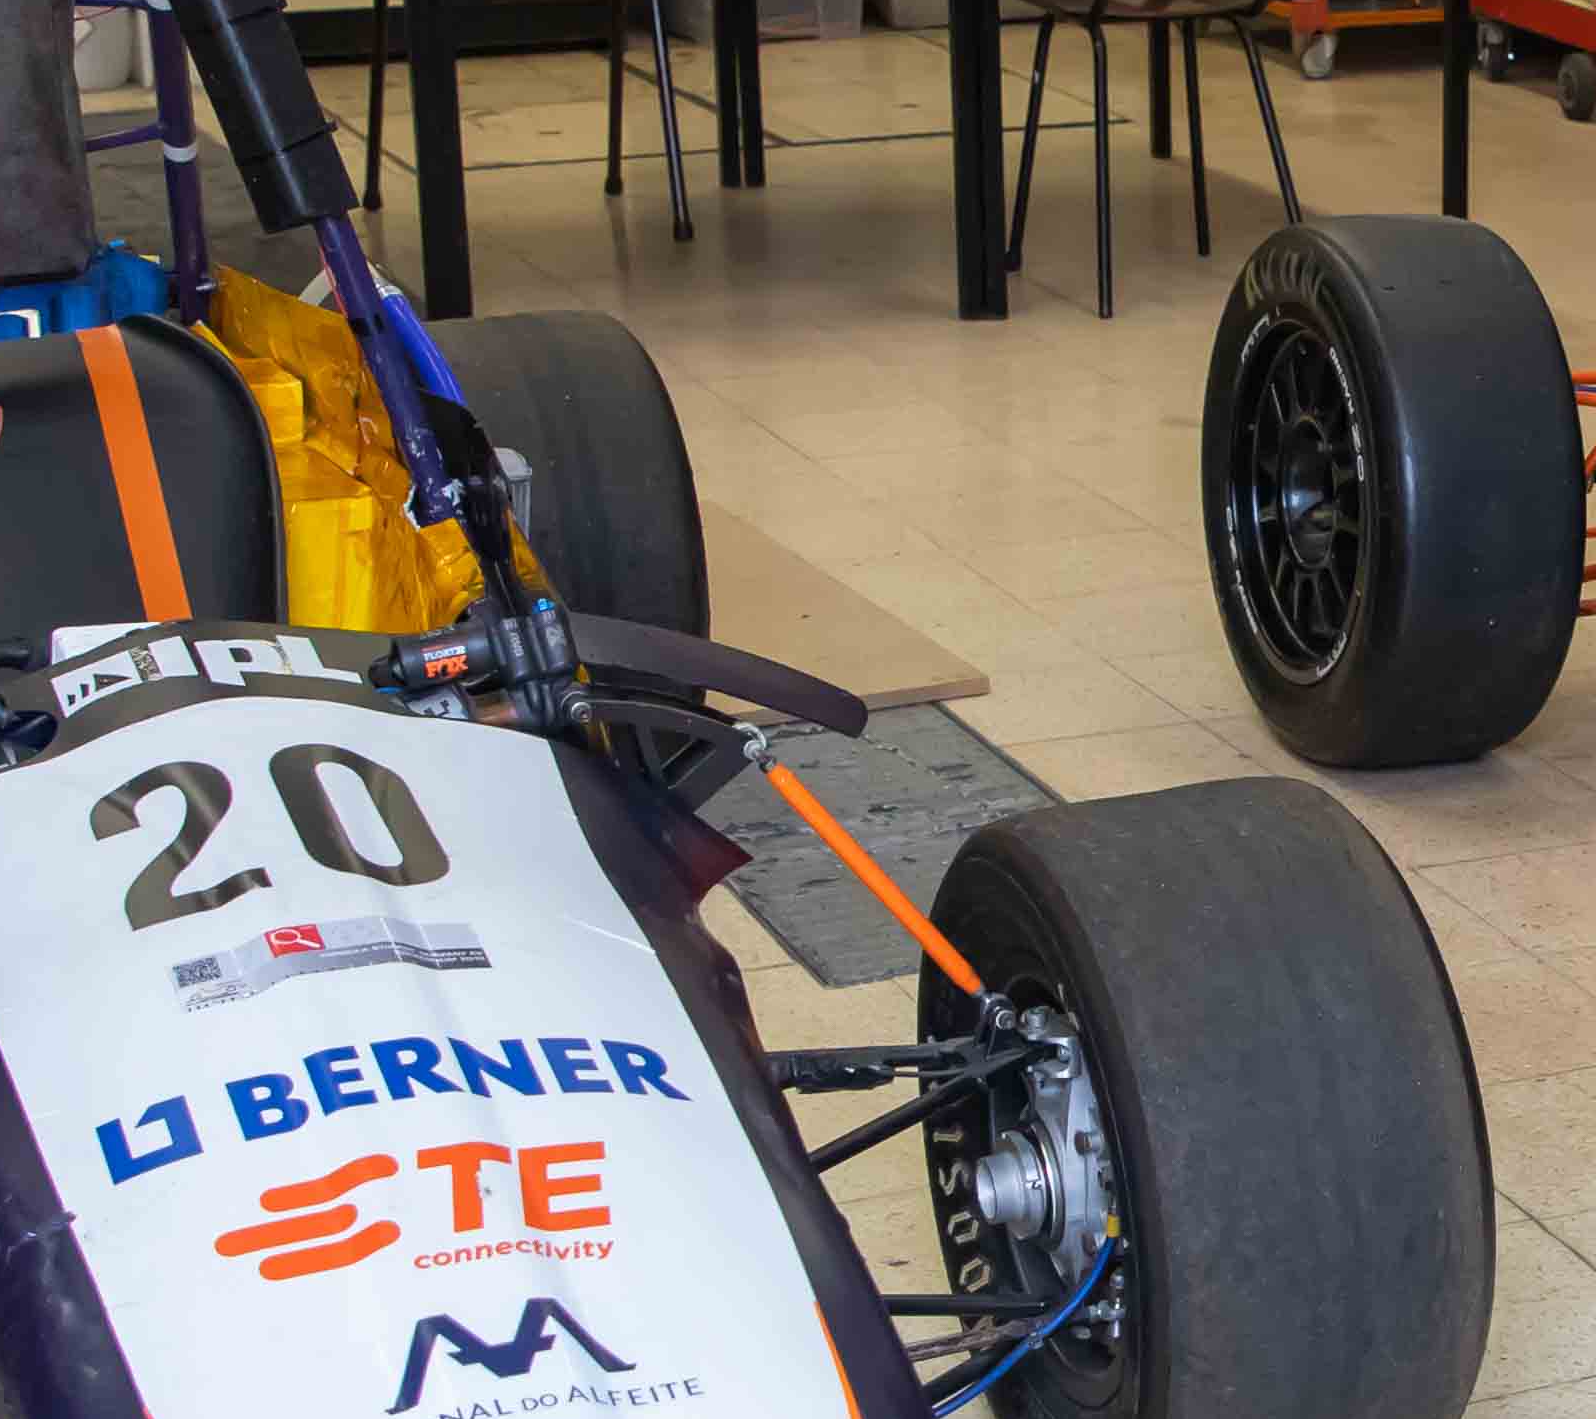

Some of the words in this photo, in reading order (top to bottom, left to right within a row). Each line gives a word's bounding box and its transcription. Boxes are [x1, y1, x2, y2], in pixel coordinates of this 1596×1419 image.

[89, 743, 451, 932] 20
[224, 1035, 694, 1142] BERNER
[416, 1139, 612, 1234] TE
[413, 1234, 615, 1271] connectivity
[520, 1390, 560, 1412] DO
[566, 1376, 706, 1408] ALFEITE
